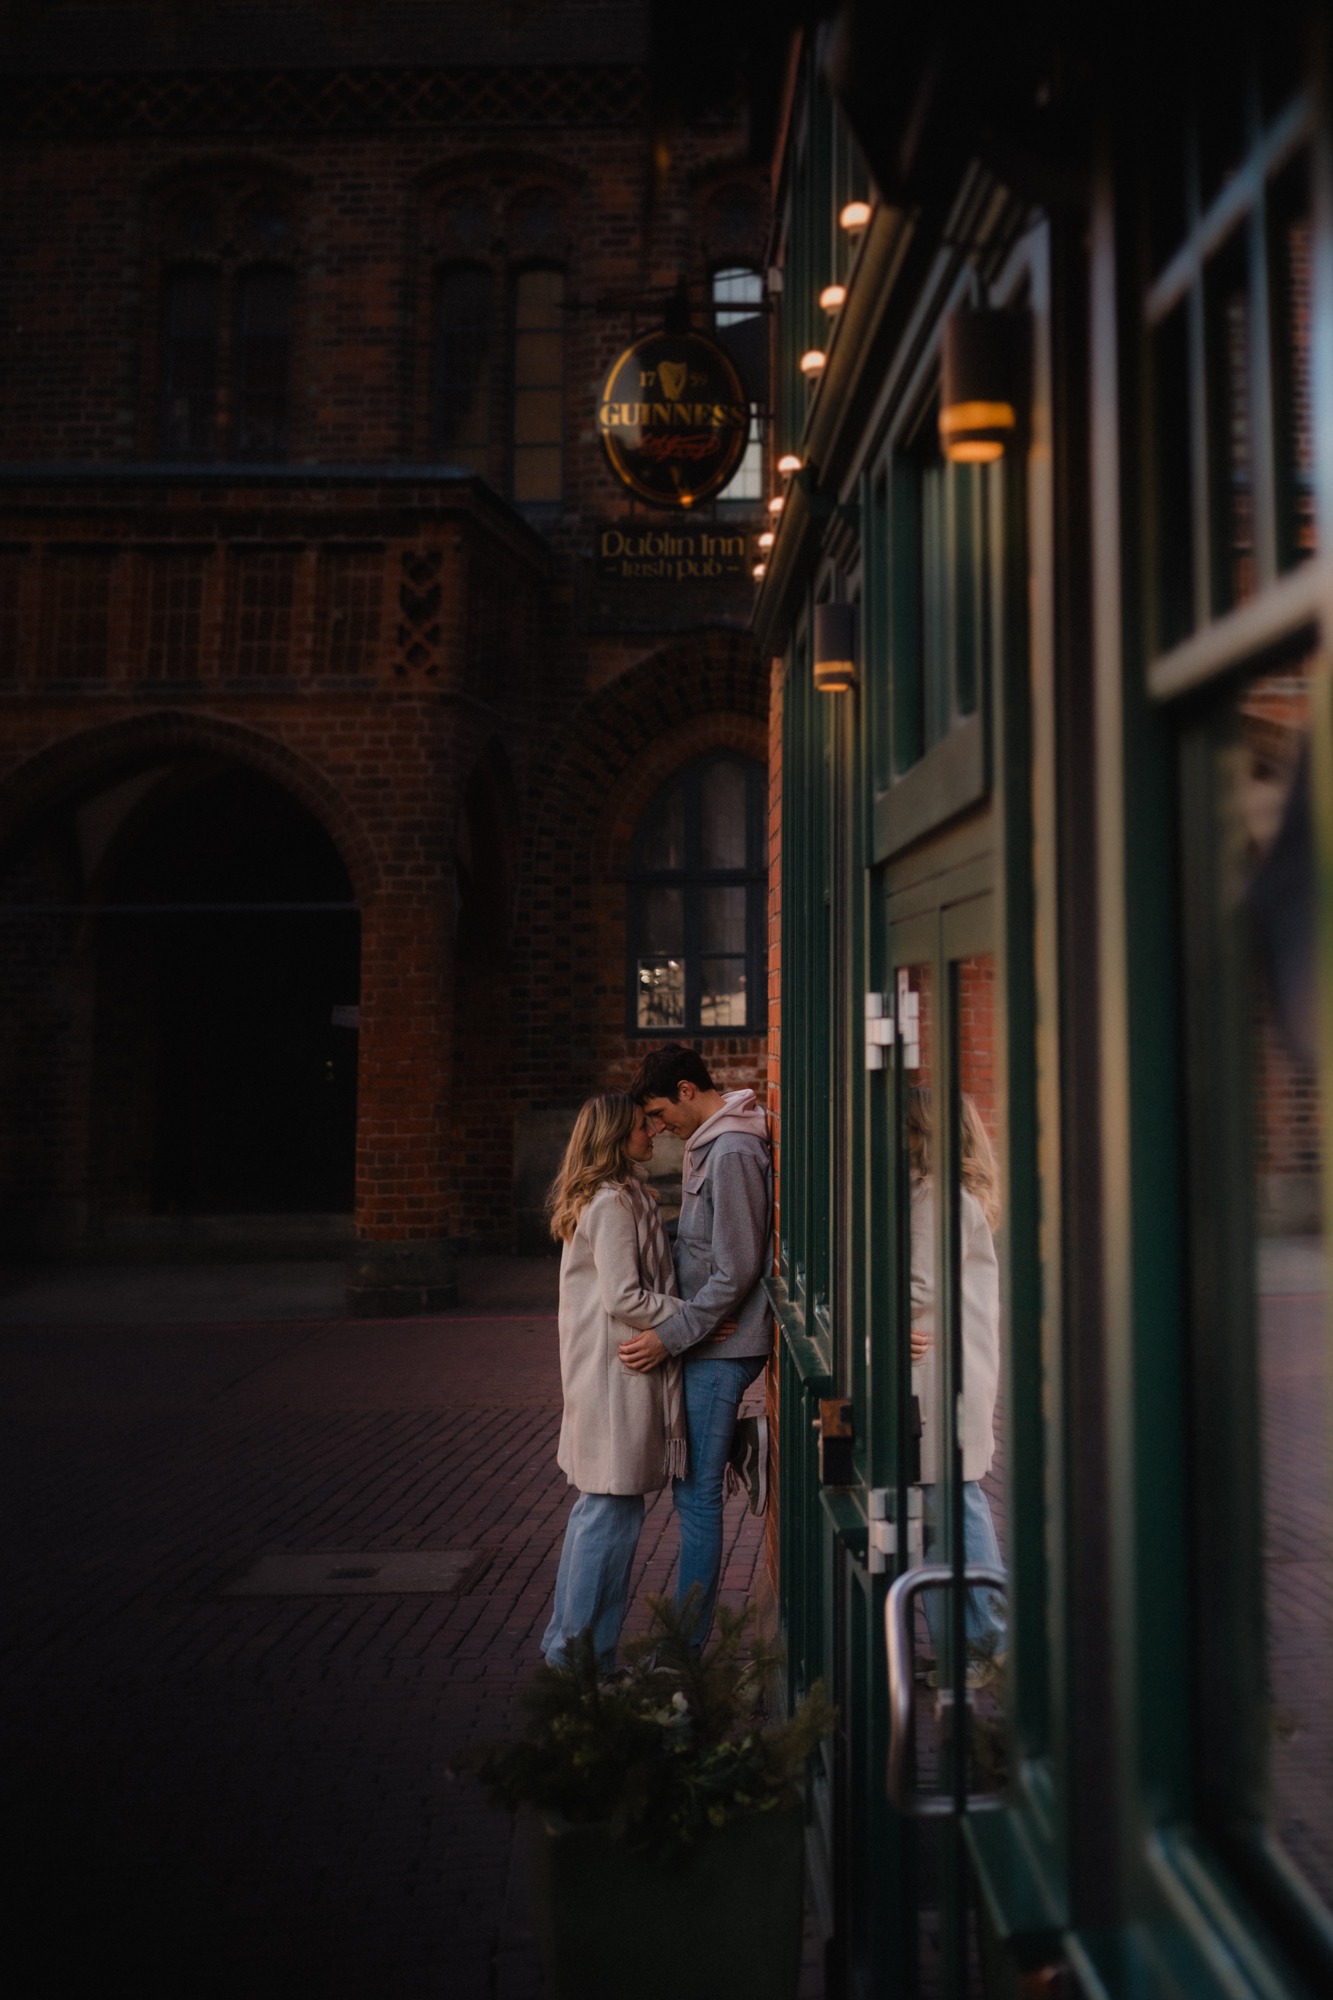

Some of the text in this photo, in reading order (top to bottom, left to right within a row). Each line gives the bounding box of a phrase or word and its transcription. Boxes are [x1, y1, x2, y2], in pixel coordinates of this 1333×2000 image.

[640, 370, 656, 387] 17
[600, 402, 747, 428] GUINNESS
[601, 529, 745, 558] Dublin Inn
[622, 559, 673, 577] Irish
